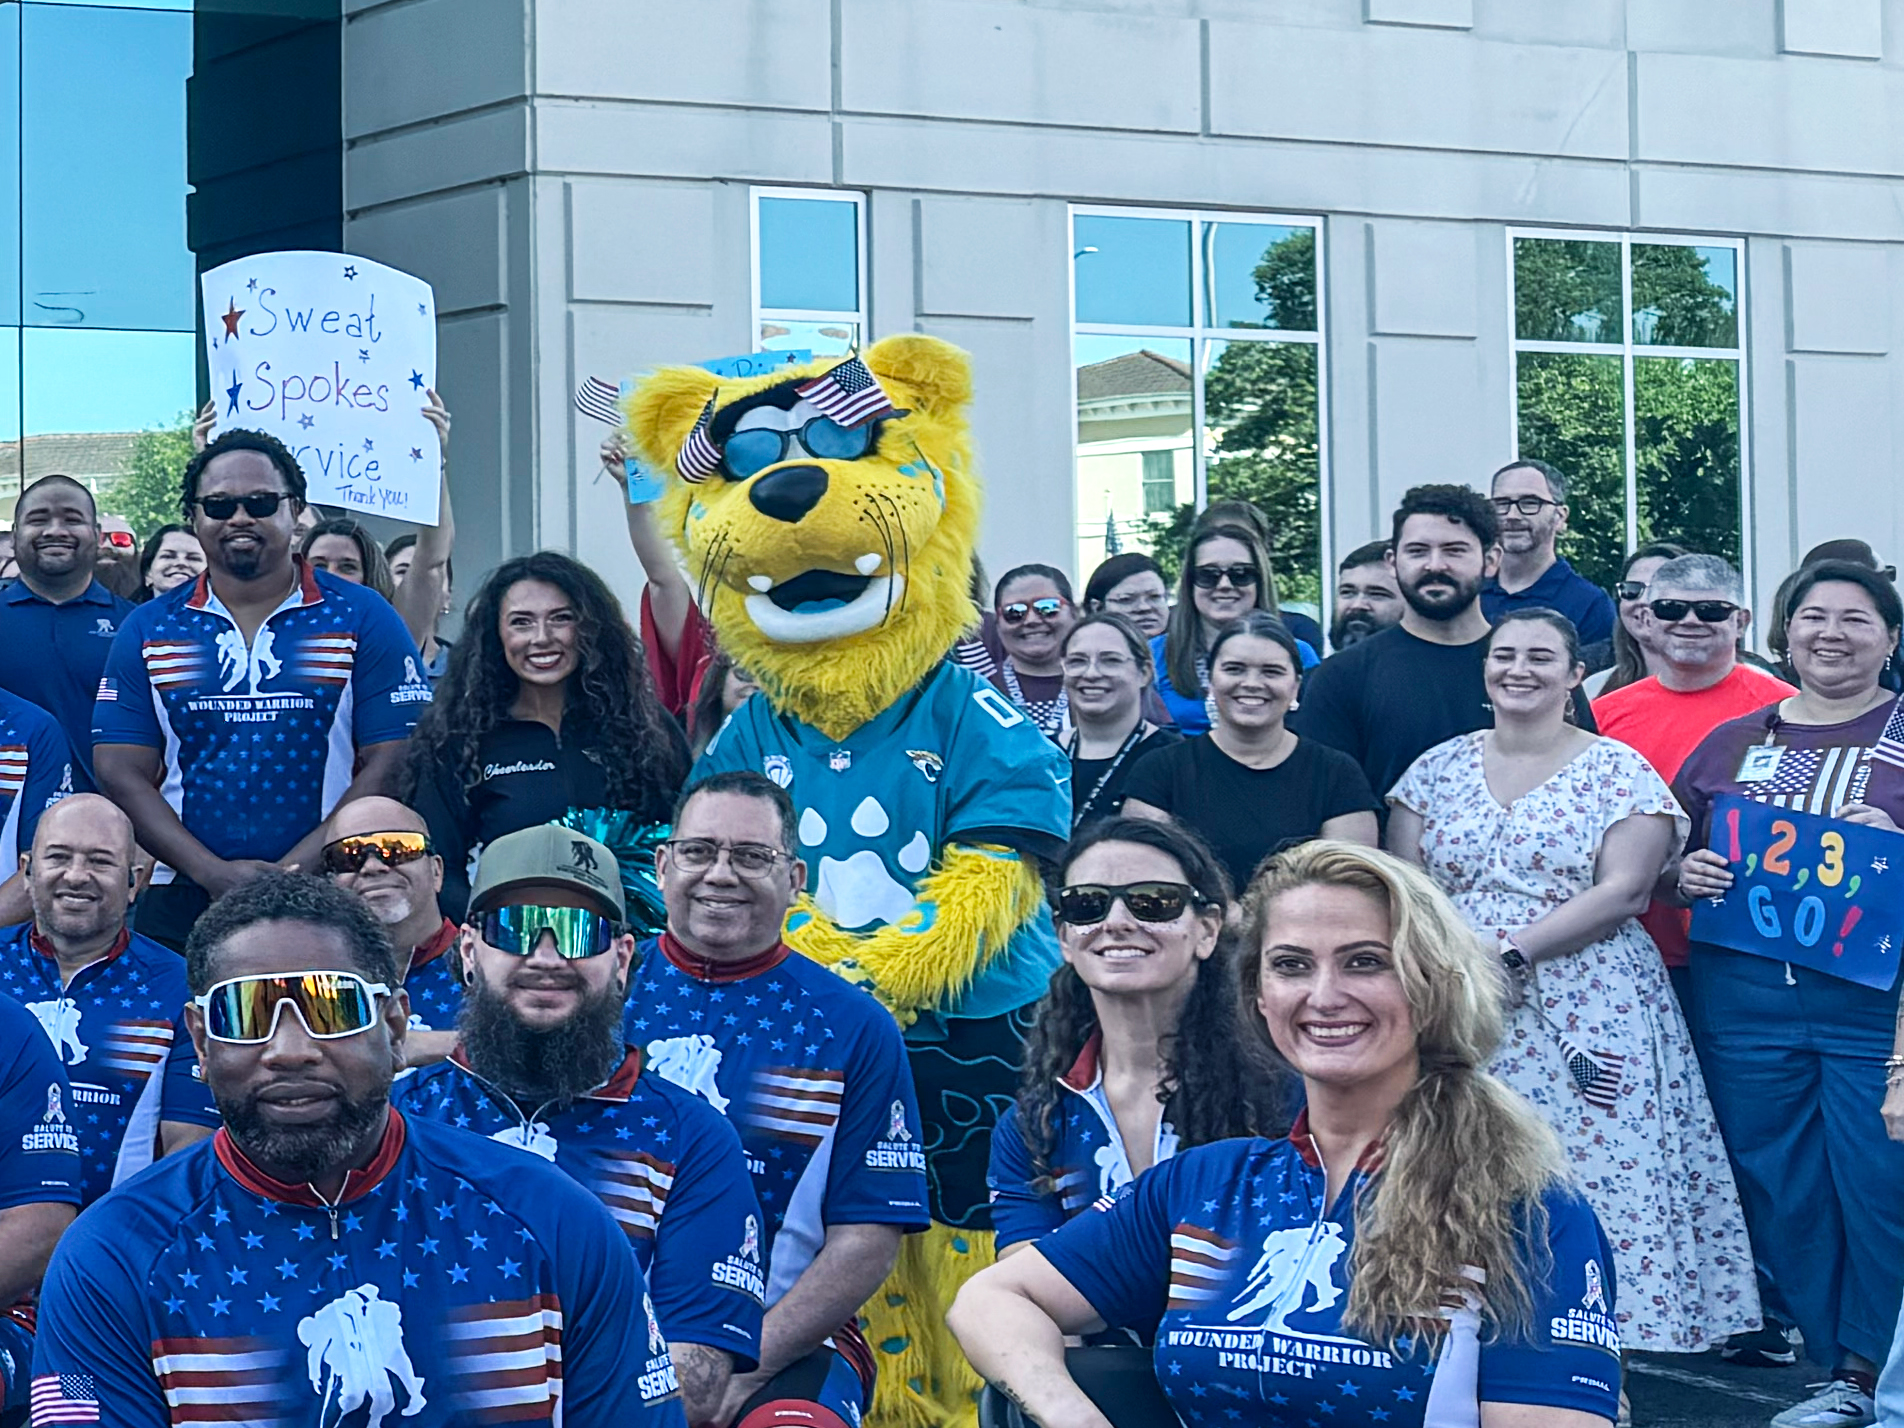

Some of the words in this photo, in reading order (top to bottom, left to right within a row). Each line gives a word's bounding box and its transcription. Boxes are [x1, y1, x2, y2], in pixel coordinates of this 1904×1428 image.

[250, 287, 382, 343] Sweat
[246, 361, 389, 420] Spokes
[291, 443, 382, 481] rvice
[1168, 1330, 1265, 1349] WOUNDED
[1272, 1336, 1393, 1370] WARRIOR
[1218, 1351, 1317, 1379] PROJECT
